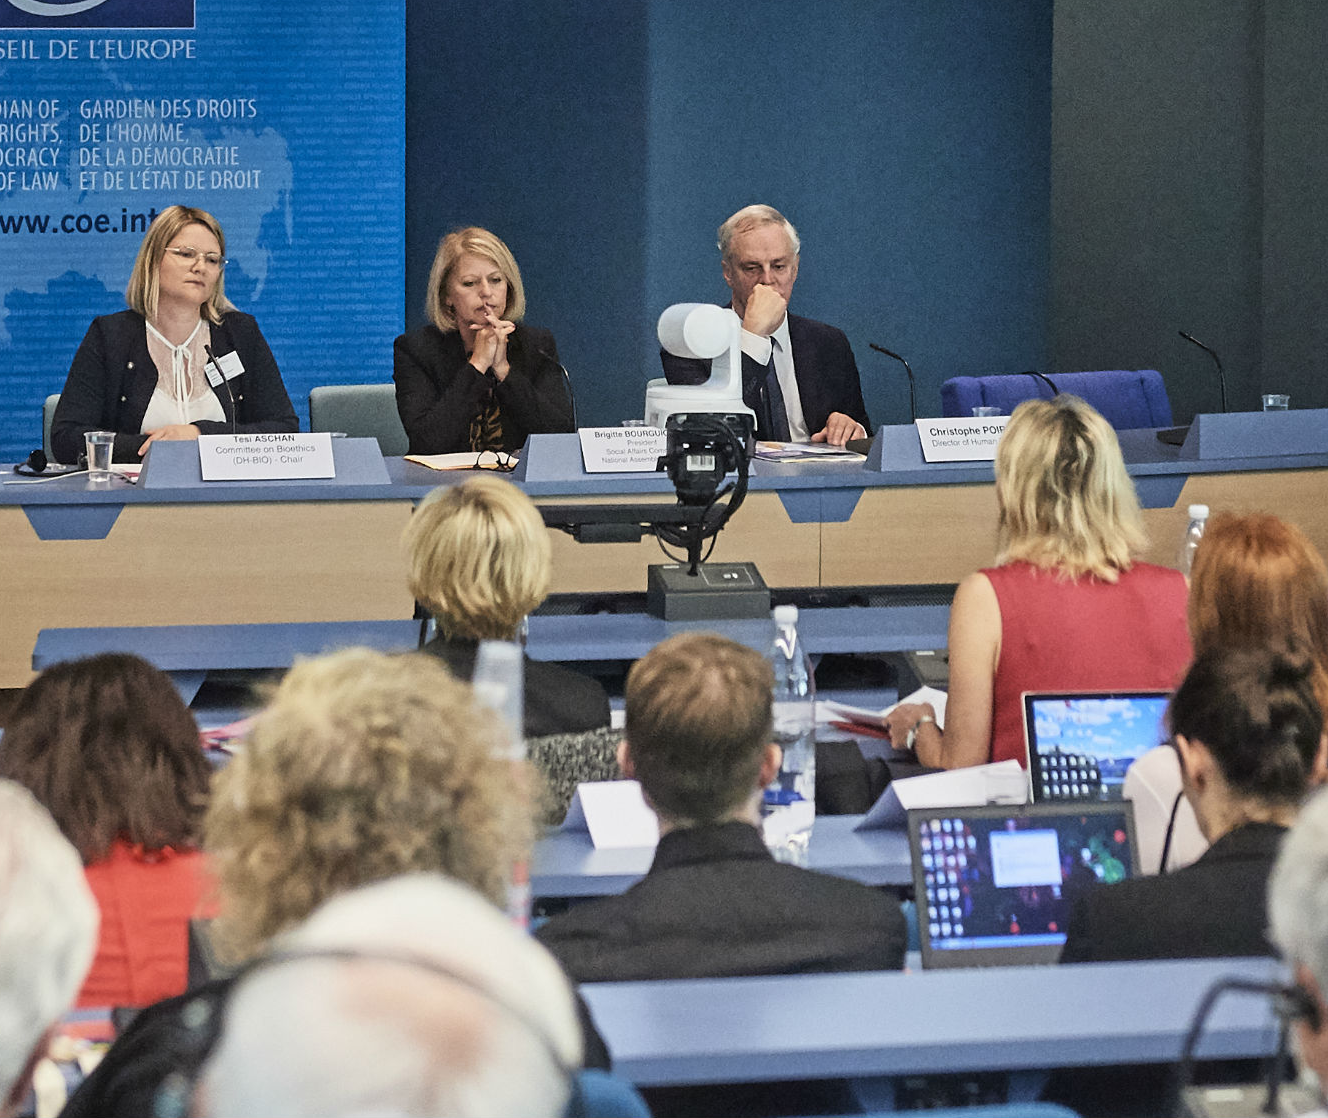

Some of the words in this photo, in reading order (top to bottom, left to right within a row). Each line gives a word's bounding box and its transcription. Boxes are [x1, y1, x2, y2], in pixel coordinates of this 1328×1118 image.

[49, 38, 80, 61] DE
[88, 37, 197, 61] L'EUROPE
[36, 99, 60, 120] OF
[79, 99, 156, 120] GARDIEN
[160, 99, 192, 119] DES
[196, 98, 257, 119] DROITS
[79, 123, 101, 143] DE
[105, 123, 189, 145] L'HOMME,
[79, 147, 101, 167] DE
[105, 147, 126, 167] LA
[130, 143, 240, 167] DÉMOCRATIE
[20, 171, 59, 191] LAW
[79, 171, 99, 190] ET
[103, 171, 125, 190] DE
[128, 167, 183, 190] L'ÉTAT
[186, 170, 206, 190] DE
[210, 169, 262, 190] DROIT
[595, 431, 622, 439] Brigitte
[930, 427, 981, 437] Christophe
[215, 446, 261, 454] Committee
[277, 445, 315, 453] Bioethics
[932, 439, 960, 447] Director
[962, 438, 970, 446] of
[232, 455, 273, 466] (DH-BIO)
[280, 454, 304, 464] Chair
